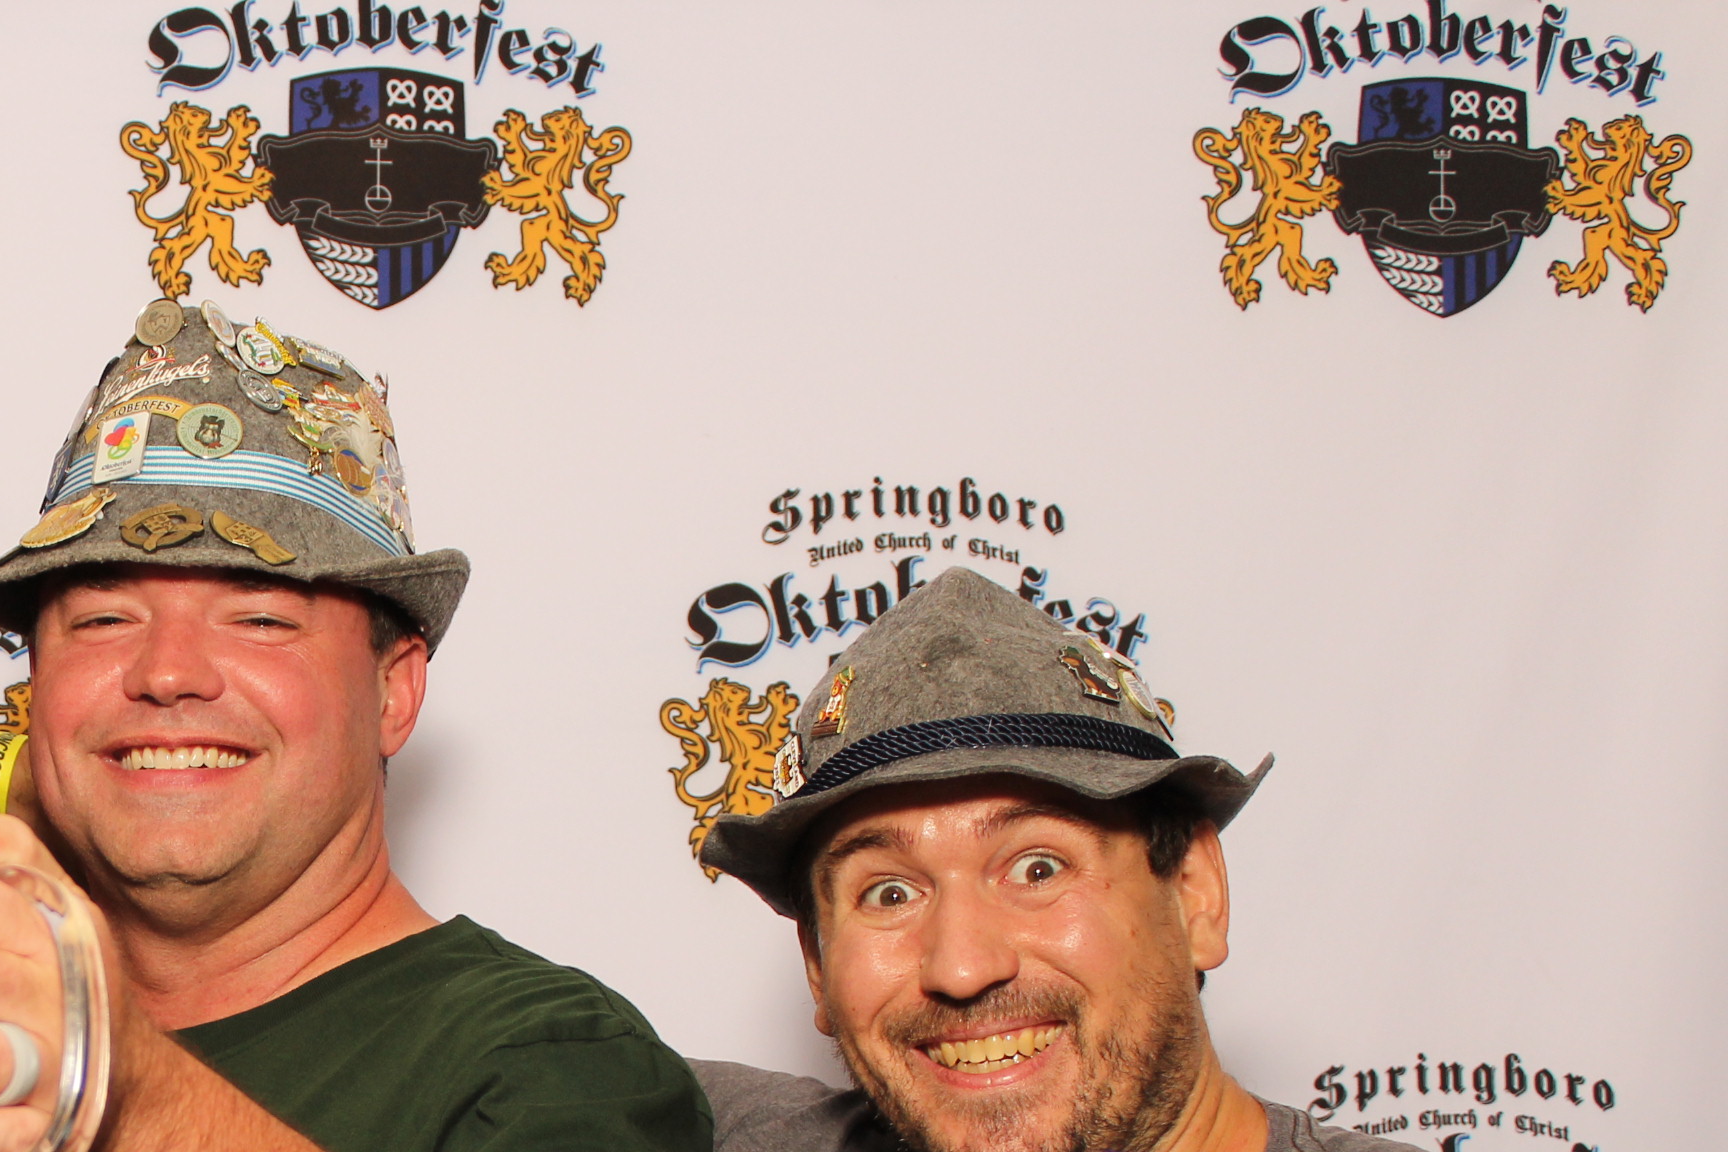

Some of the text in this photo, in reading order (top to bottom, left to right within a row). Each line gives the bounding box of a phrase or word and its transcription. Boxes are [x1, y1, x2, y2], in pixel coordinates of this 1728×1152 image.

[146, 0, 604, 97] Oktoberfest
[1217, 0, 1664, 107] Oktoberfest
[762, 476, 1065, 544] Springboro
[807, 531, 1021, 566] United Church of Christ
[1307, 1052, 1616, 1122] Springboro
[1419, 1109, 1478, 1130] Church
[1488, 1111, 1504, 1127] of
[1515, 1114, 1571, 1143] Christ
